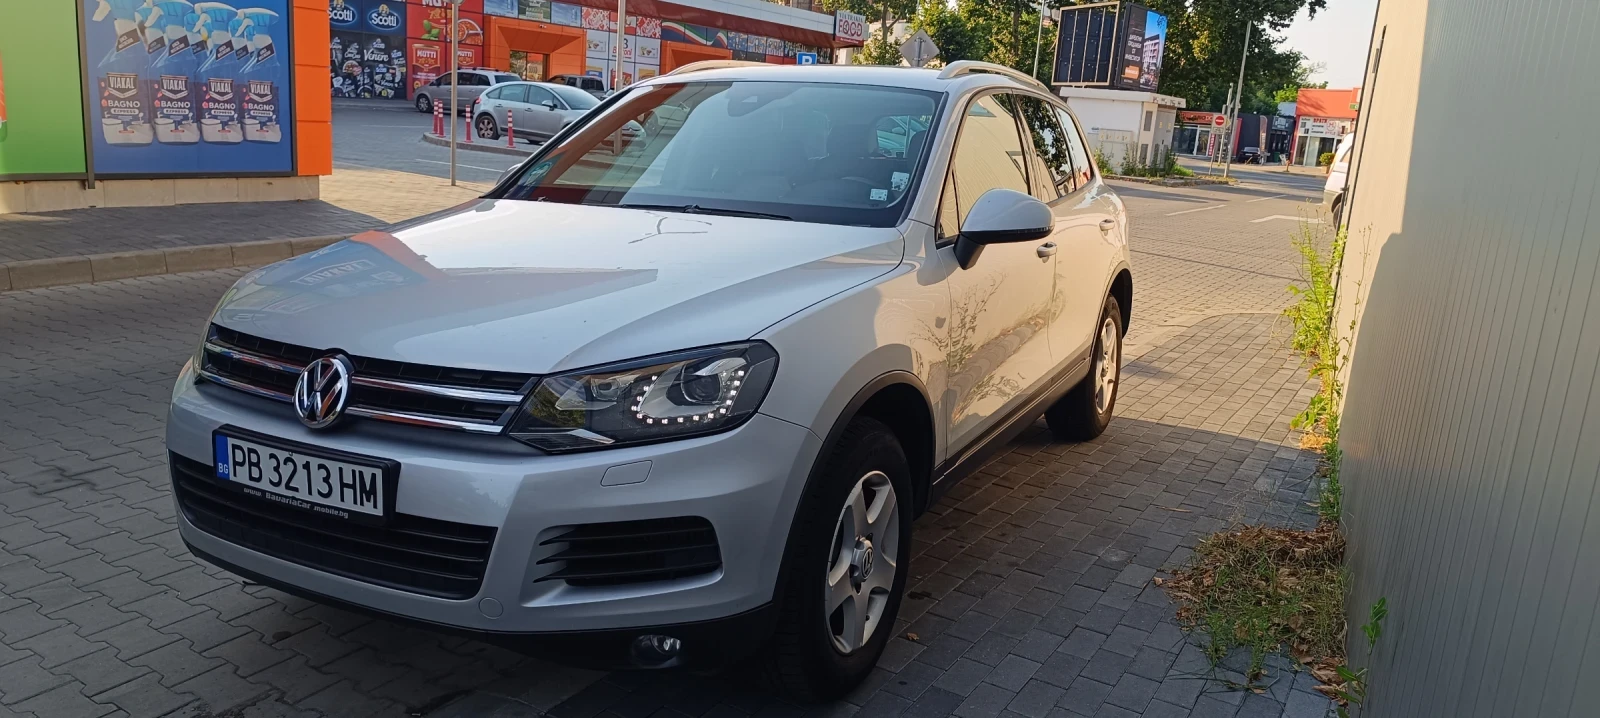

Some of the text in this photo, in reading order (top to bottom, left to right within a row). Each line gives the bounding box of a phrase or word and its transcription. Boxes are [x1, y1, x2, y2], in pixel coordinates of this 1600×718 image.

[371, 13, 397, 27] Scotti
[363, 48, 389, 62] Venere
[417, 49, 436, 58] MUTTI
[801, 55, 813, 65] P
[109, 77, 135, 89] VIAKAL
[162, 79, 186, 91] VIAKAL
[210, 82, 232, 93] VIAKAL
[250, 84, 271, 94] VIAKAL
[108, 100, 140, 108] BAGNO
[160, 100, 191, 108] BAGNO
[218, 462, 229, 475] BG
[231, 443, 379, 510] PB 3213 HM
[266, 491, 312, 510] BavariaCar
